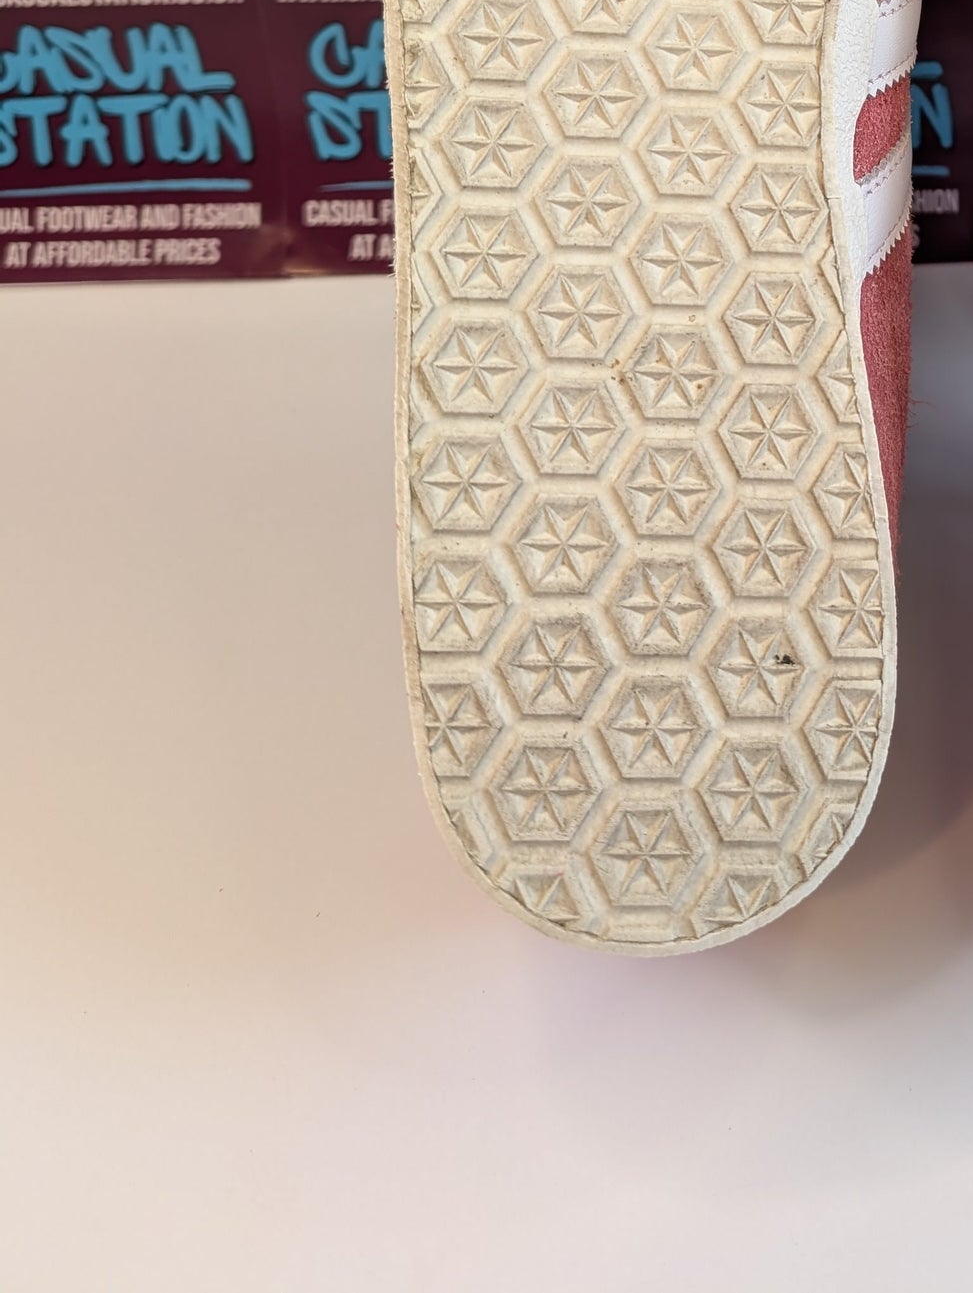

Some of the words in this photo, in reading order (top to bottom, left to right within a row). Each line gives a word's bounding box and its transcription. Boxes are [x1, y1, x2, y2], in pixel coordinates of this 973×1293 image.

[36, 205, 138, 232] FOOTWEAR
[140, 204, 181, 230] AND
[182, 202, 262, 229] FASHION
[303, 199, 379, 227] CASUAL
[5, 241, 31, 268] AT
[32, 239, 152, 267] AFFORDABLE
[152, 237, 221, 265] PRICES
[348, 233, 376, 261] AT
